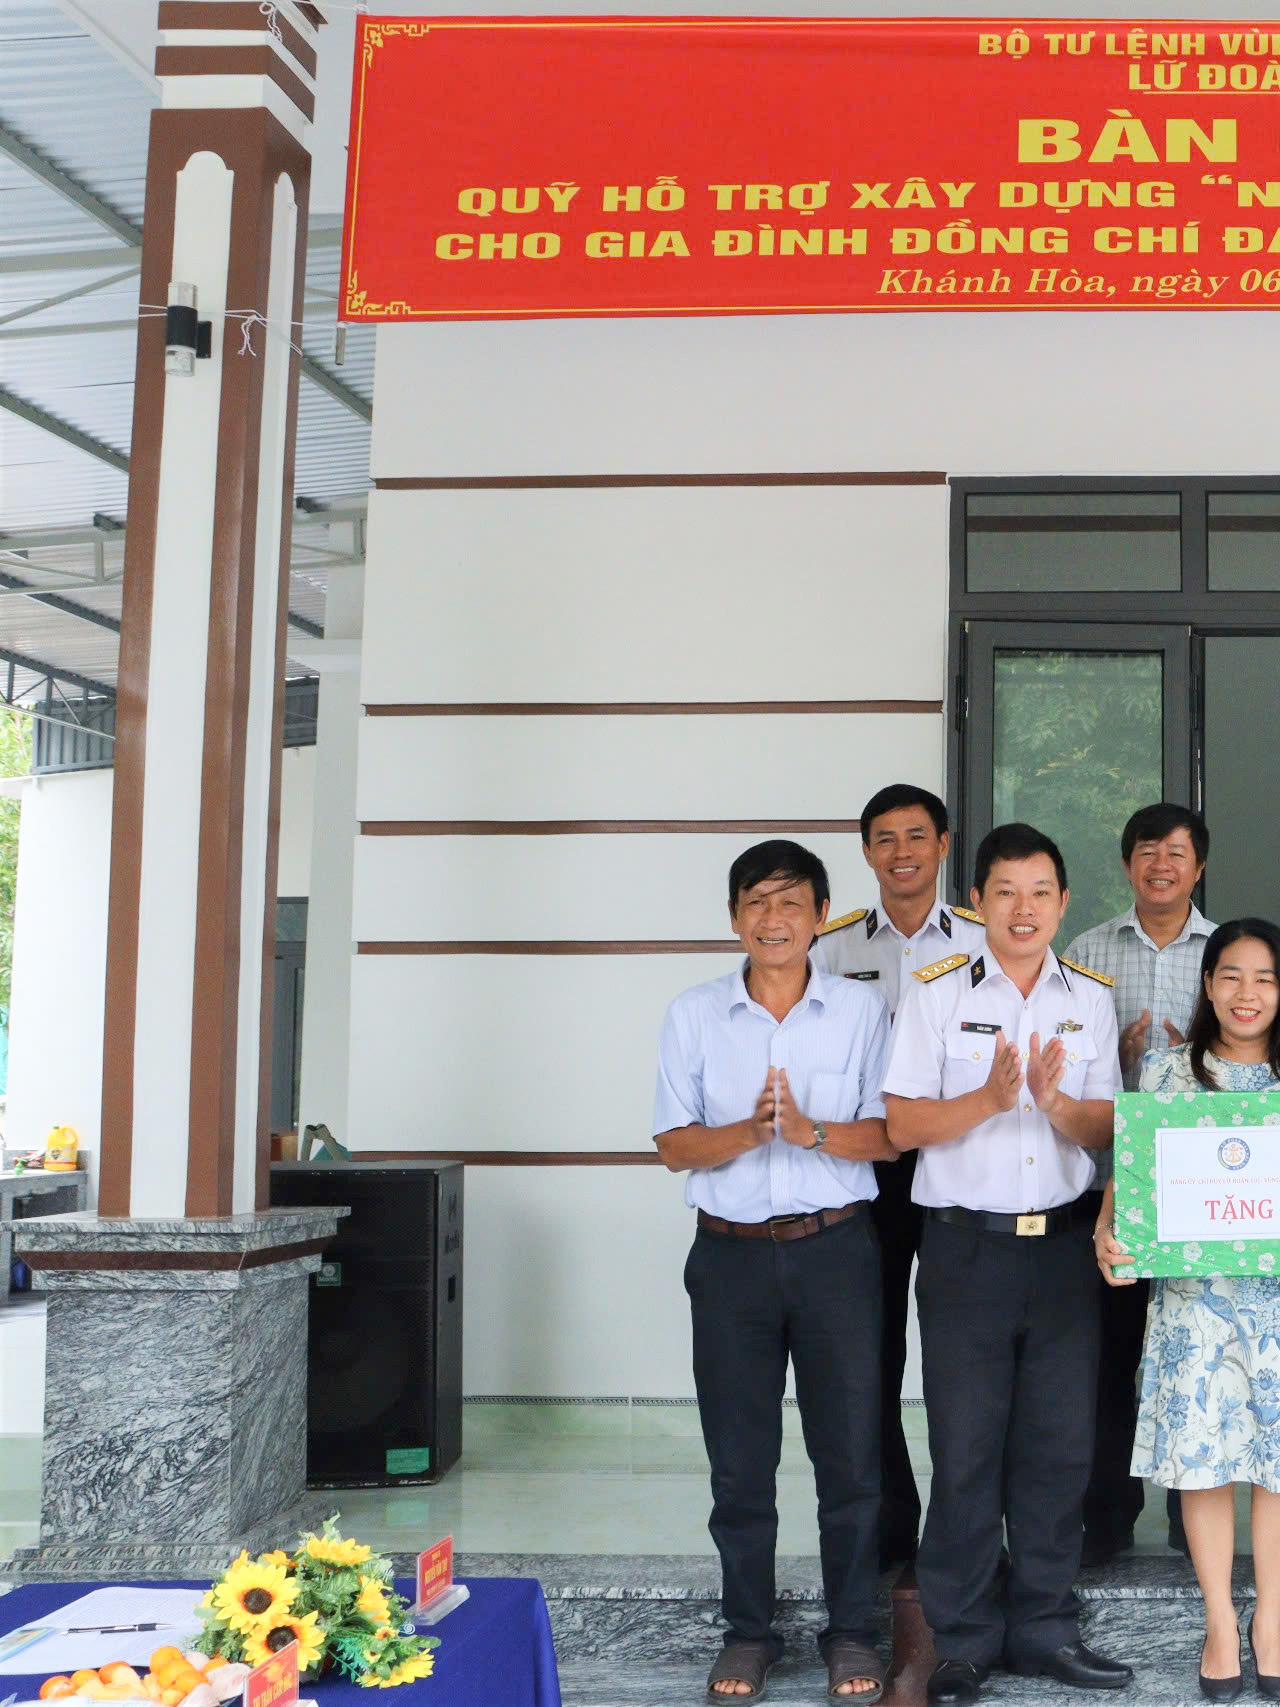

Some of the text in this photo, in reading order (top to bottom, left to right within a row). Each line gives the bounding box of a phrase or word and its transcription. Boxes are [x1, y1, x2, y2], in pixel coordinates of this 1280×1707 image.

[978, 29, 1030, 57] BỘ
[1043, 31, 1097, 55] TƯ
[1105, 29, 1206, 57] LỆNH
[1128, 60, 1188, 91] LỮ
[1017, 108, 1237, 163] BÀN
[457, 181, 581, 217] QUỸ
[602, 175, 685, 212] HỖ
[707, 180, 830, 215] TRỢ
[850, 176, 977, 209] XÂY
[999, 178, 1175, 214] DỰNG
[435, 233, 561, 261] CHO
[585, 230, 691, 259] GIA
[711, 223, 868, 257] ĐÌNH
[889, 218, 1069, 255] ĐỒNG
[1093, 221, 1199, 254] CHÍ
[876, 268, 1011, 295] Khánh
[1024, 268, 1116, 298] Hòa,
[1129, 268, 1230, 299] ngày
[1204, 1194, 1273, 1225] TẶNG
